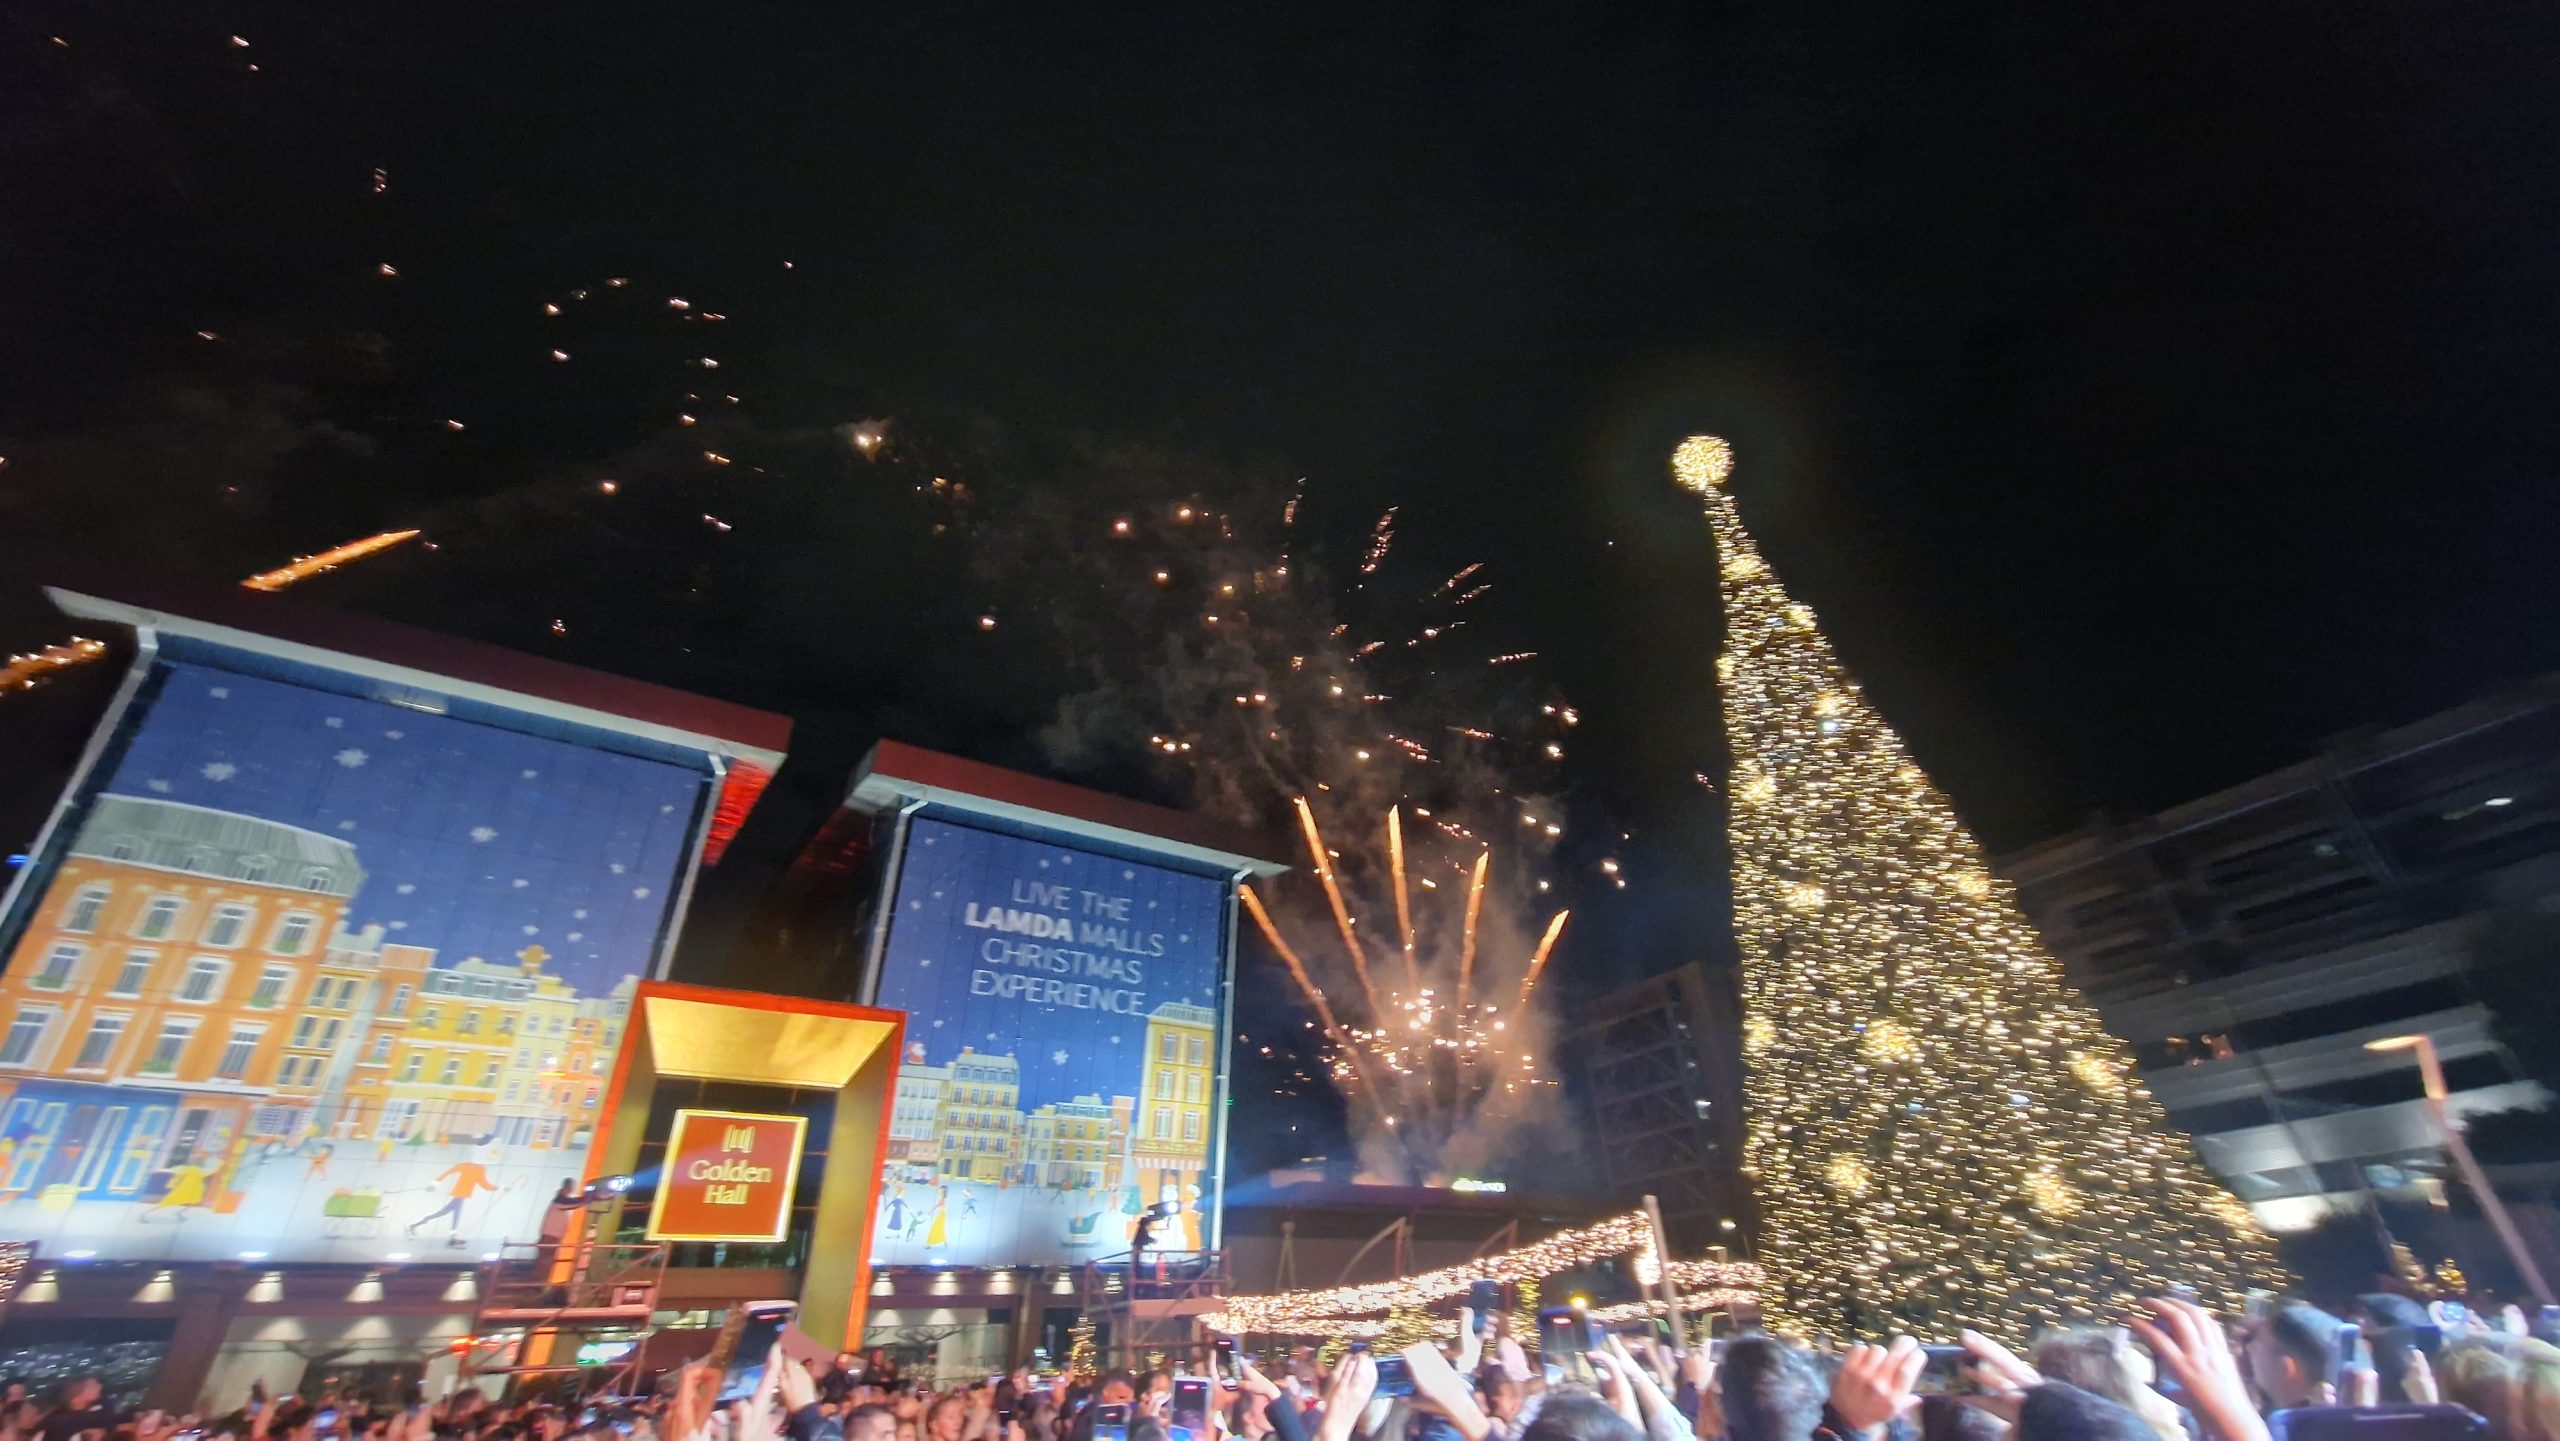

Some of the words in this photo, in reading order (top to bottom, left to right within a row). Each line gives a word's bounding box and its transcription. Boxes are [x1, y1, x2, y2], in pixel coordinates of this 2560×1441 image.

[1012, 878, 1072, 910] LIVE
[1080, 890, 1133, 921] THE
[965, 902, 1074, 942] LAMDA
[1080, 922, 1166, 957] MALLS
[981, 938, 1143, 984] CHRISTMAS
[971, 969, 1147, 1016] EXPERIENCE
[688, 1158, 772, 1183] Golden
[703, 1184, 749, 1205] Hall
